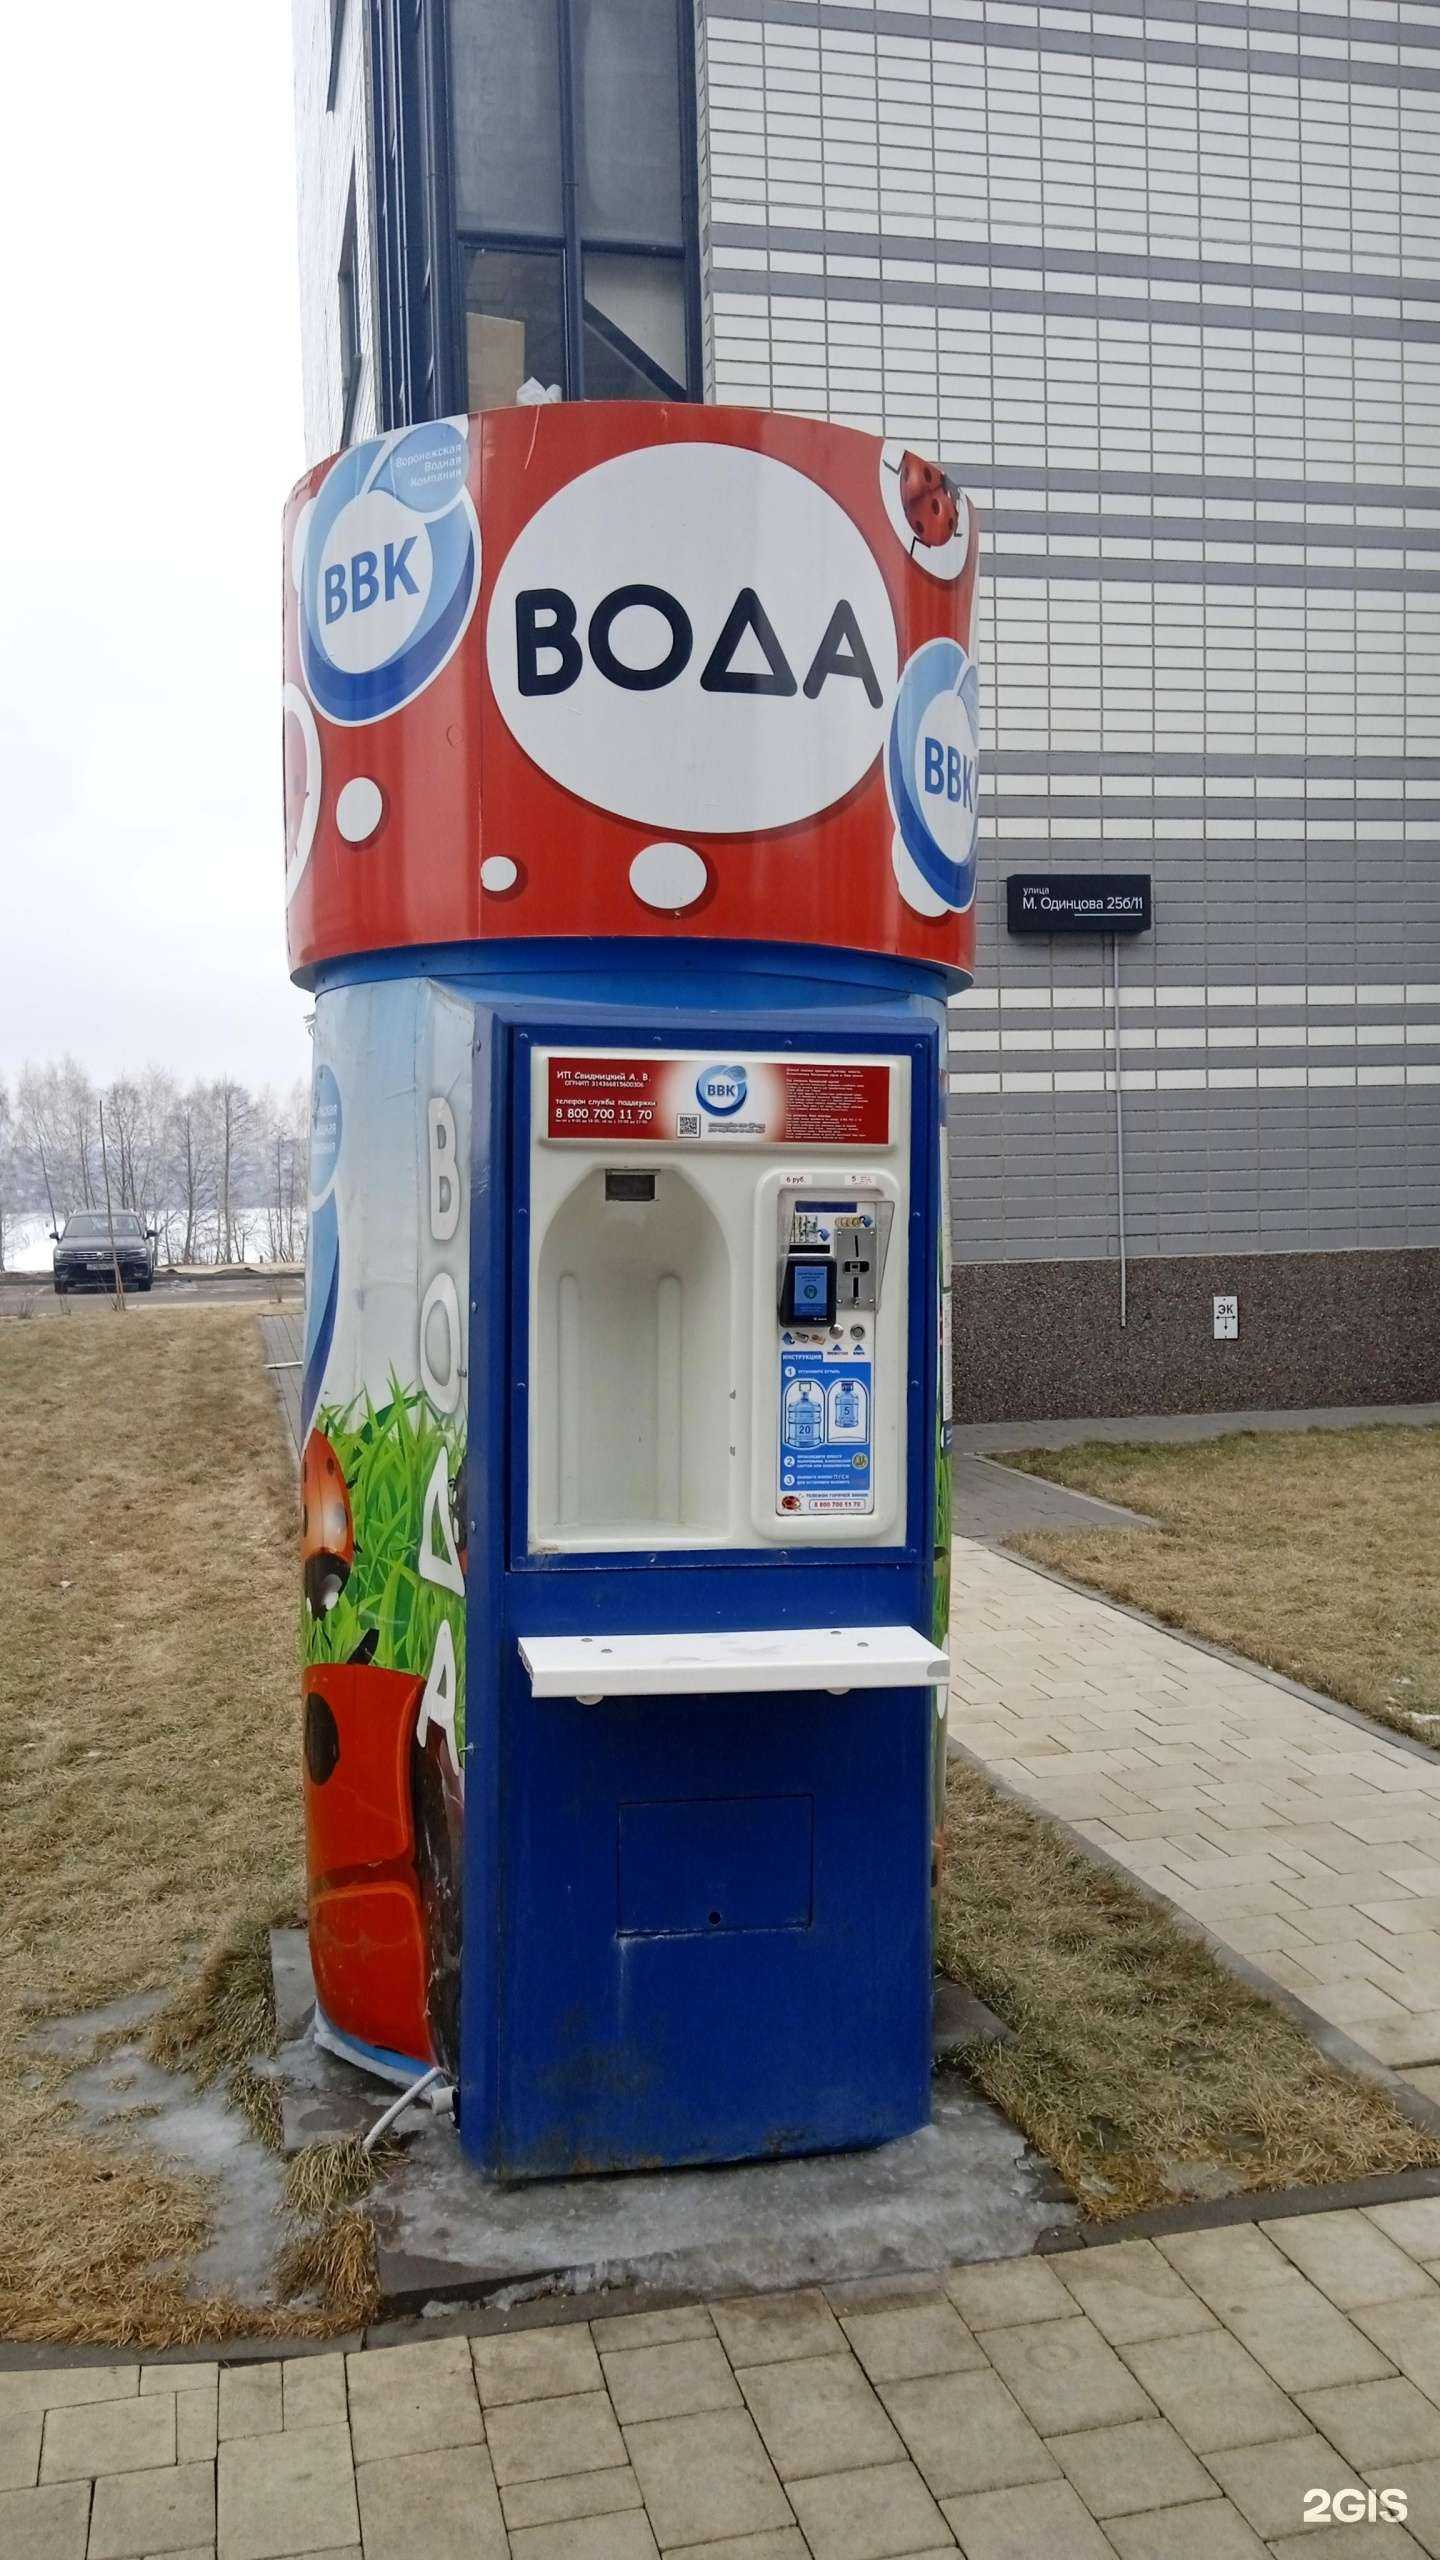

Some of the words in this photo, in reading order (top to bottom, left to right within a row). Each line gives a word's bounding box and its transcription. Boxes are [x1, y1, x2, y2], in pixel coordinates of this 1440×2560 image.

[324, 535, 421, 626] ВВК
[515, 583, 885, 710] ВОДА
[924, 736, 974, 815] ВВК
[1023, 887, 1050, 896] улица
[1023, 897, 1037, 909] М.
[1041, 897, 1104, 911] Одинцова
[556, 1071, 571, 1079] ИП
[707, 1084, 736, 1096] ВВК
[555, 1108, 563, 1118] 8
[567, 1108, 589, 1119] 800
[593, 1108, 615, 1119] 700
[619, 1109, 632, 1119] 11
[638, 1109, 652, 1120] 70
[1218, 1304, 1234, 1315] ЭК
[844, 1407, 850, 1415] 5
[799, 1425, 811, 1434] 20
[416, 1097, 466, 1778] ВОДА
